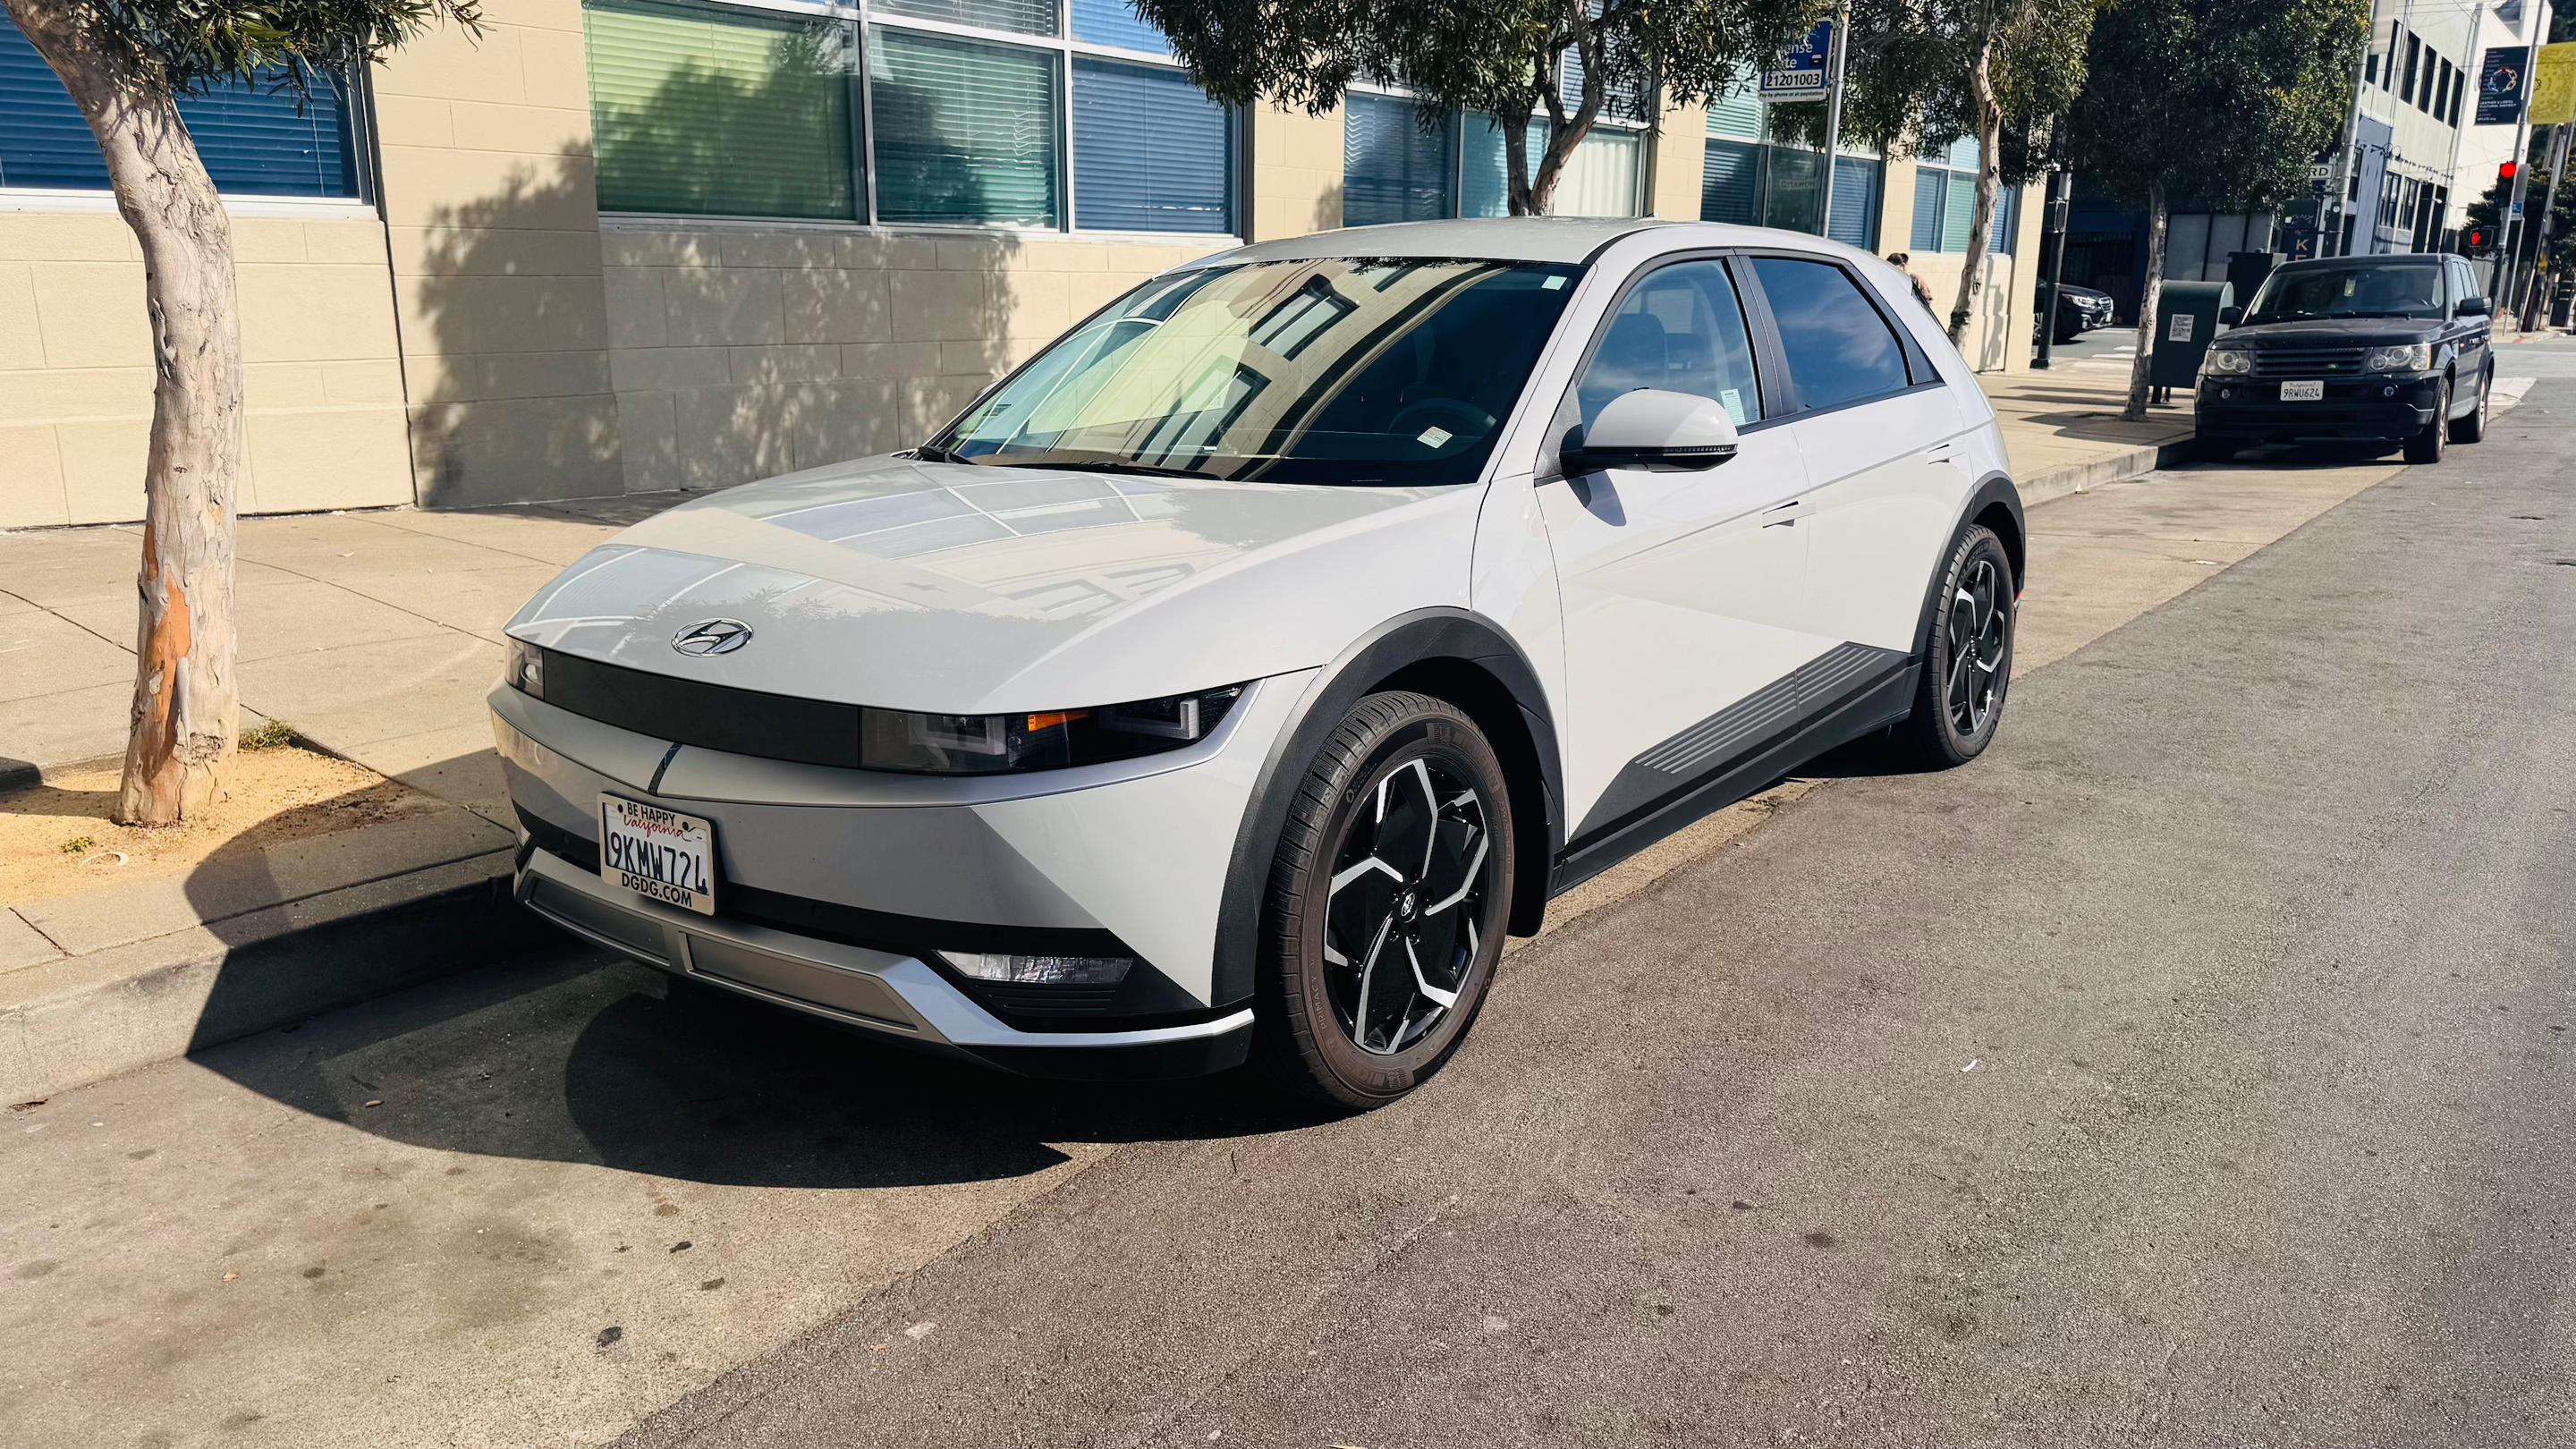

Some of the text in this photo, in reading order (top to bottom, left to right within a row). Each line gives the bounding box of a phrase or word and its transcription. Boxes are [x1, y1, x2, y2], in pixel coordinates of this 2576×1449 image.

[1766, 73, 1820, 87] 21201003
[2284, 388, 2319, 399] 9RWU624
[627, 801, 675, 826] BE HAPPY
[610, 832, 709, 895] 9KMW724
[622, 872, 692, 908] DGDG.COM
